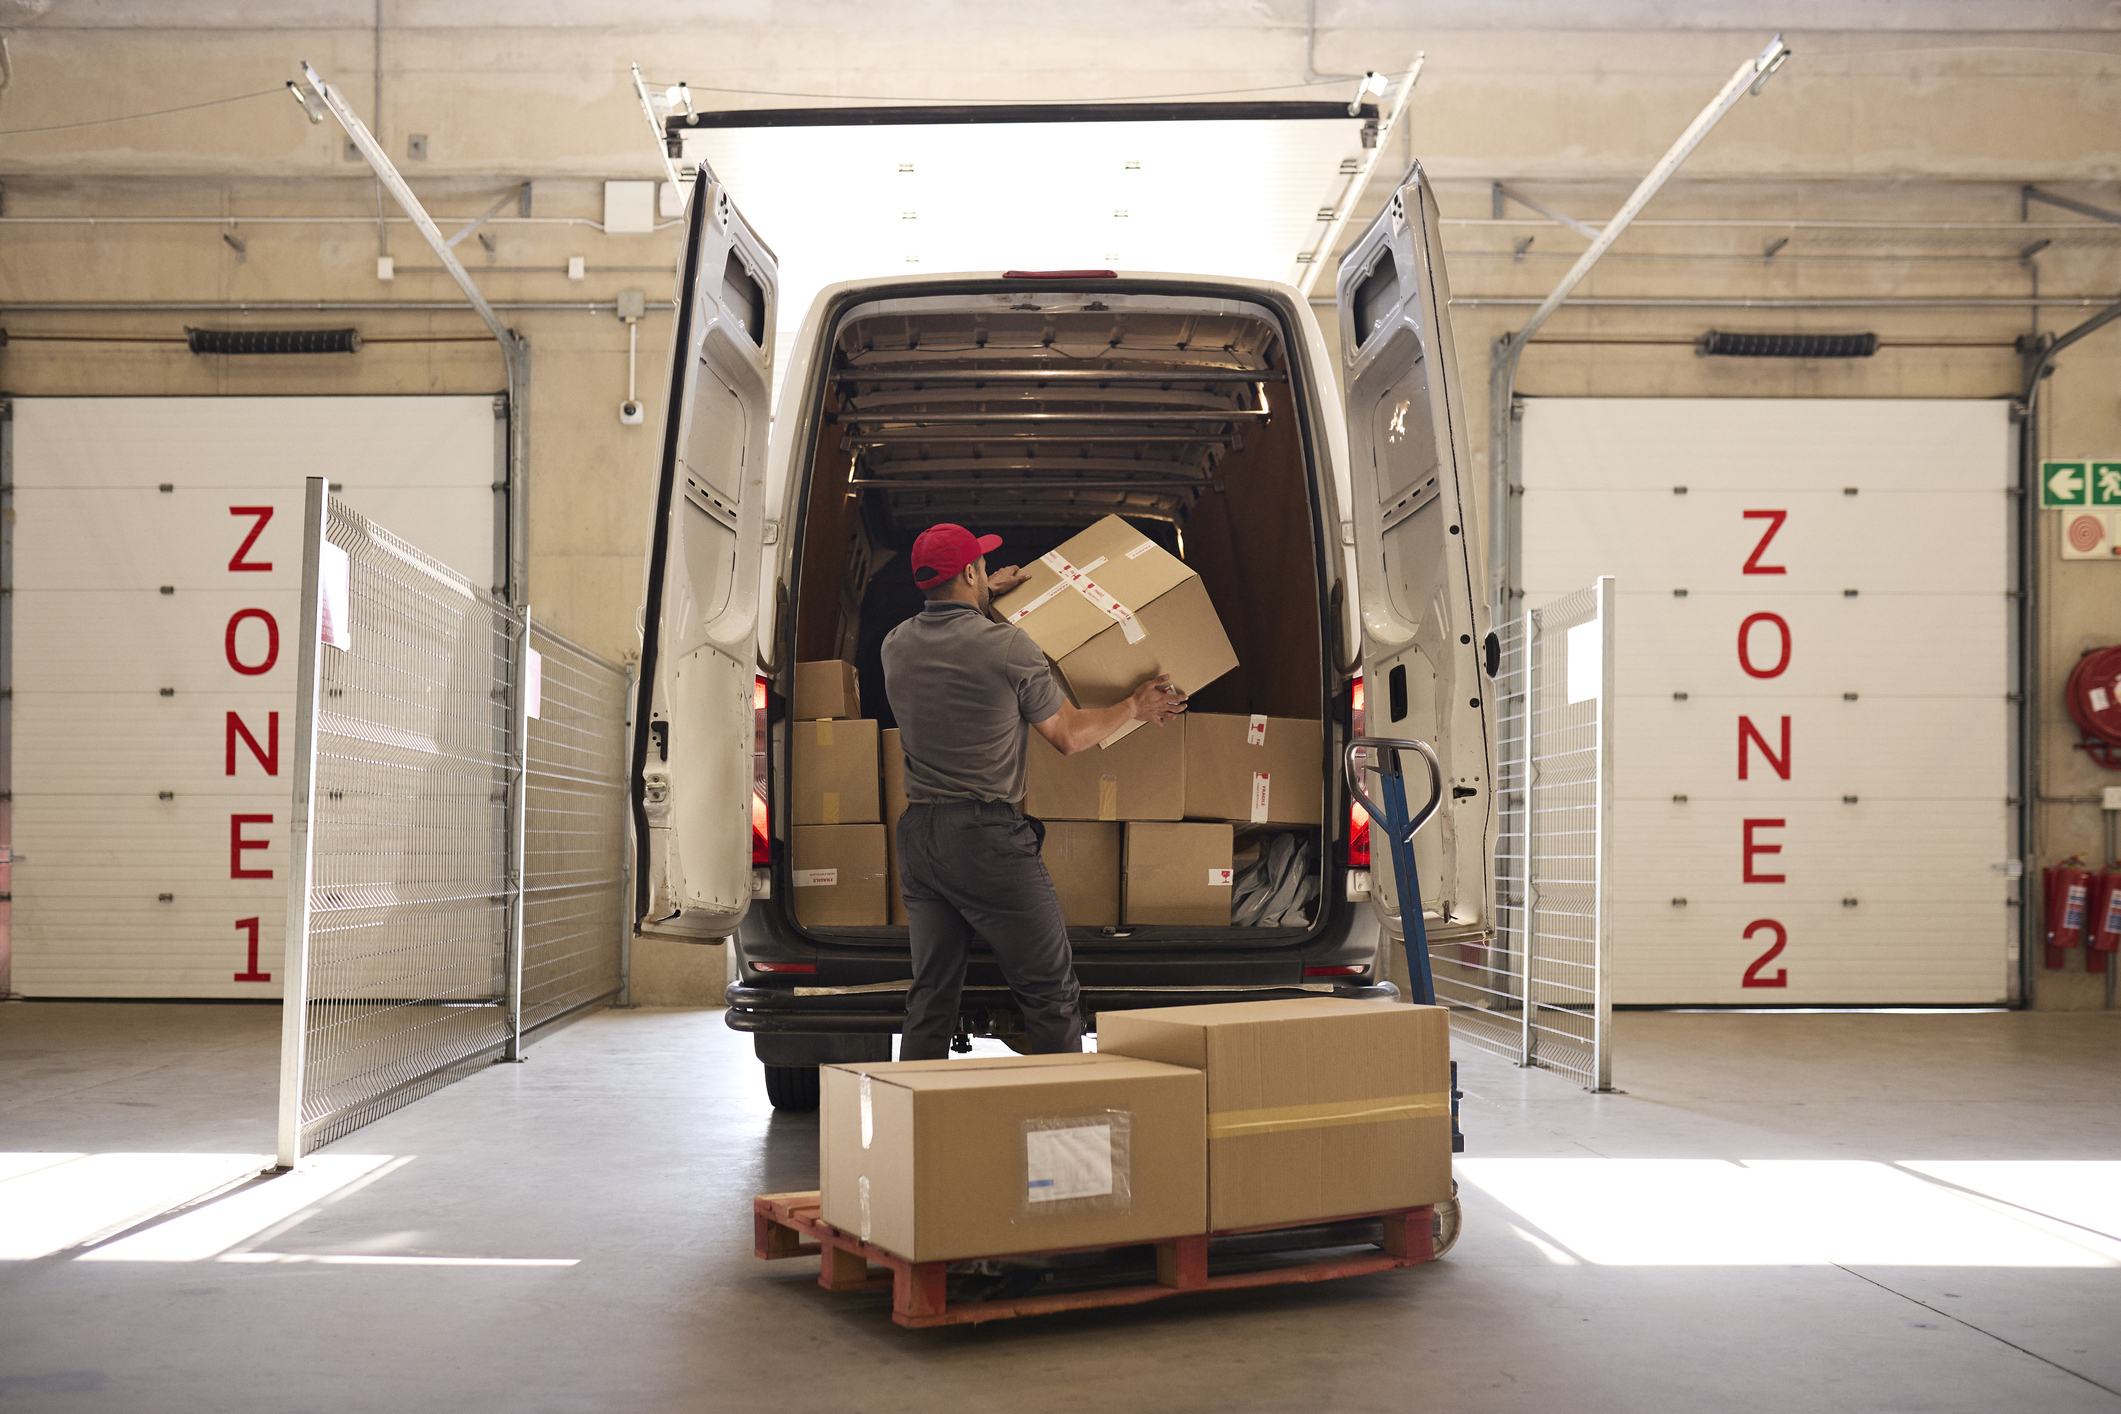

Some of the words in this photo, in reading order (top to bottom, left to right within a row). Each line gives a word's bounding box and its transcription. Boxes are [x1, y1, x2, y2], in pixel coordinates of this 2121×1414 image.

[224, 504, 280, 880] ZONE
[1736, 508, 1792, 885] ZONE
[231, 915, 272, 984] 1
[1740, 917, 1791, 990] 2
